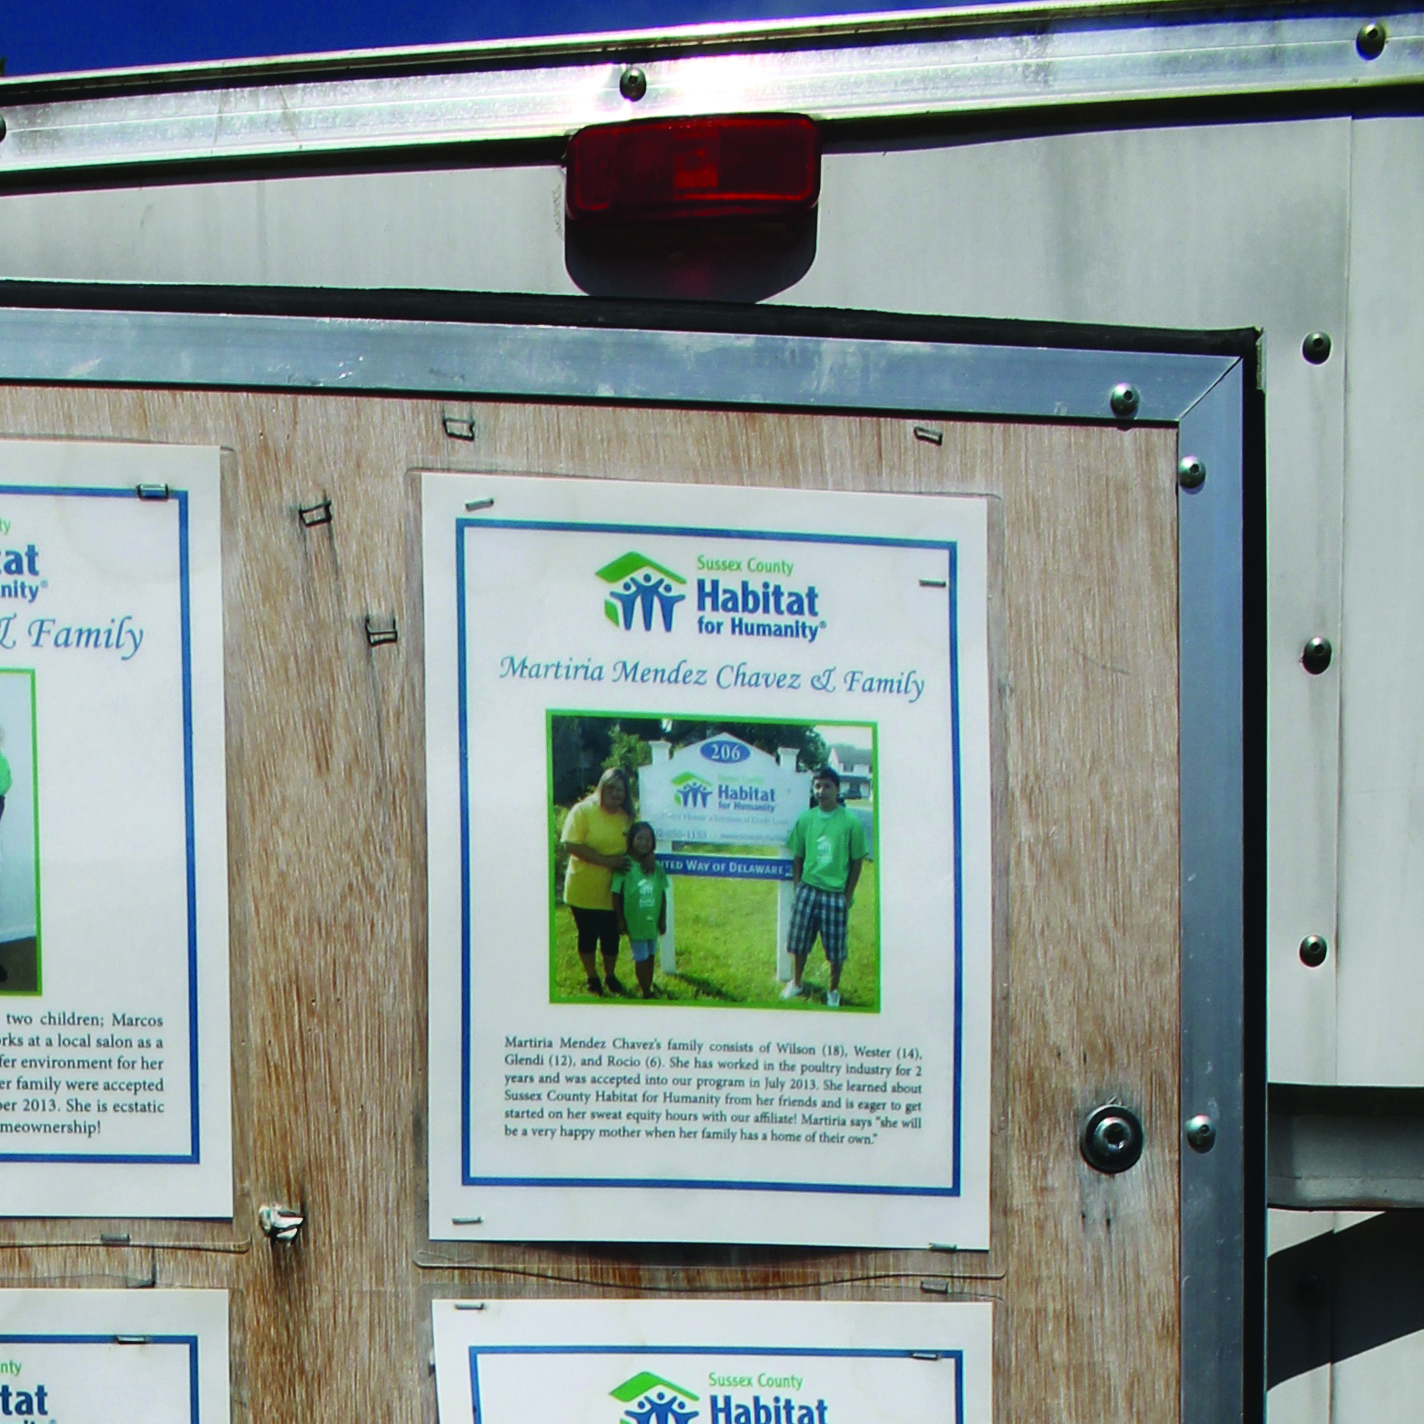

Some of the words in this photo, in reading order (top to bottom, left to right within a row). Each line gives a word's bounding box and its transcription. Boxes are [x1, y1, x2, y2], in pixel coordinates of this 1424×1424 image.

[698, 555, 742, 571] Sussex
[748, 558, 793, 576] County
[697, 578, 819, 619] Habitat
[698, 615, 724, 634] for
[28, 615, 143, 660] Family
[500, 655, 604, 681] Martiria
[612, 659, 707, 685] Mendez
[716, 662, 801, 689] Chavez
[844, 670, 924, 703] Family
[711, 744, 740, 760] 206
[718, 785, 776, 802] Habitat
[709, 1372, 752, 1386] Sussex
[758, 1373, 802, 1390] County
